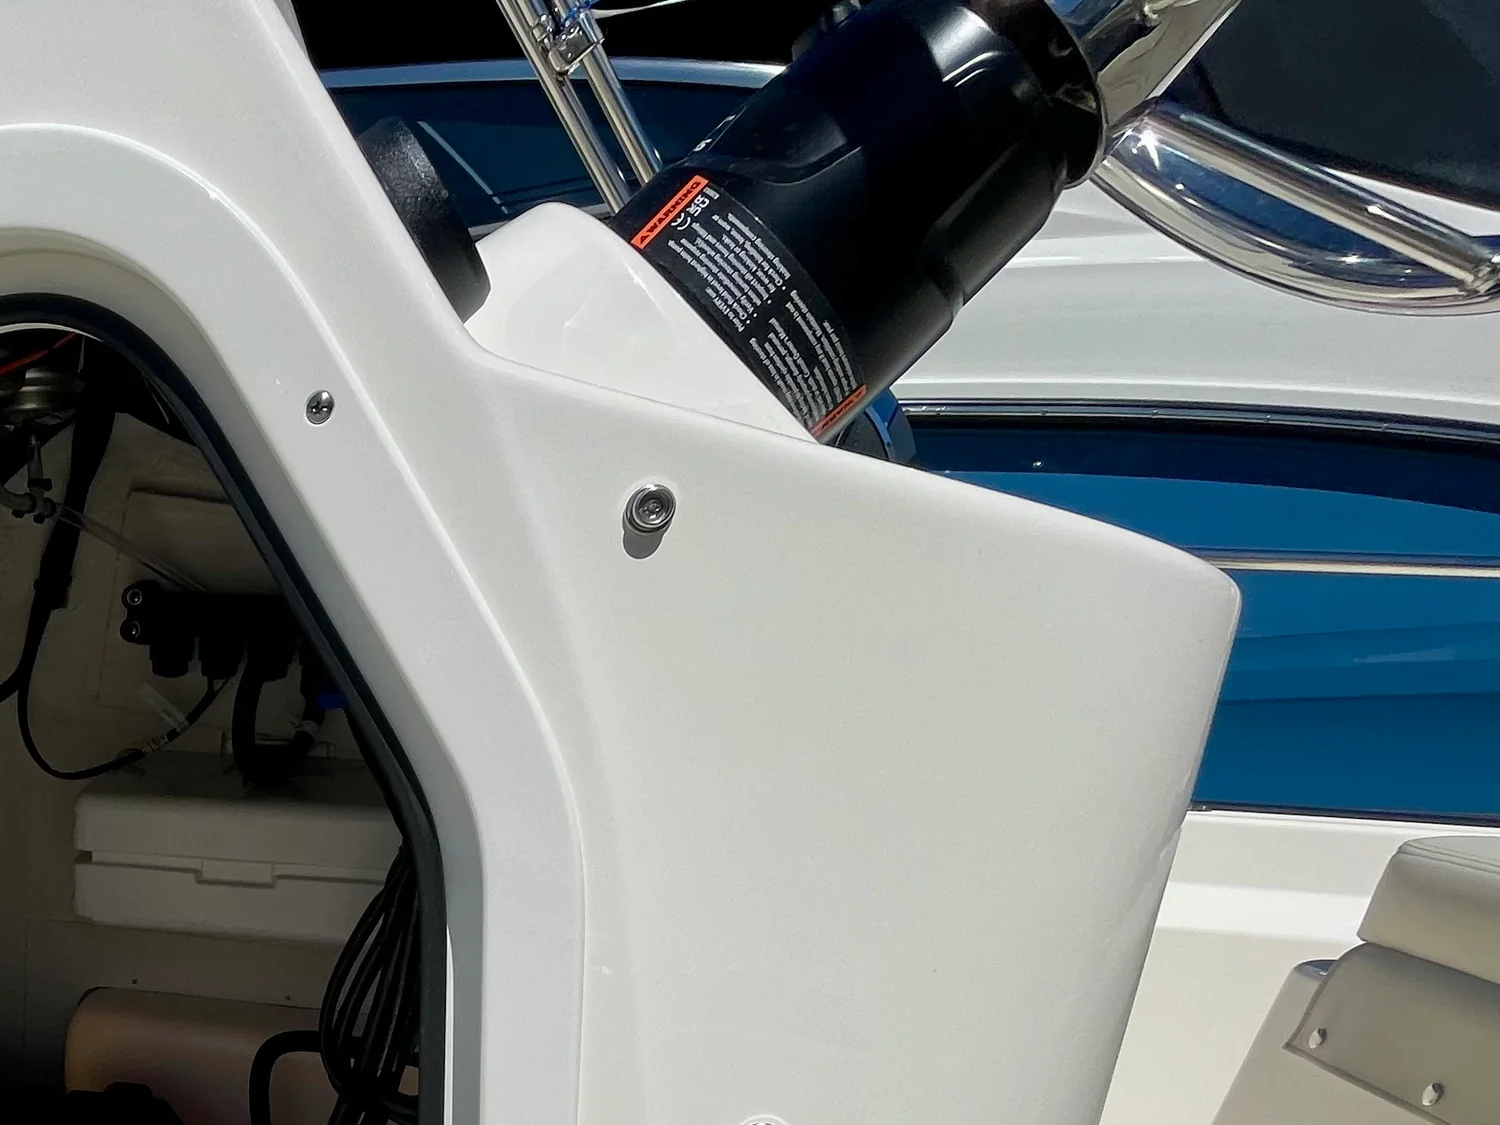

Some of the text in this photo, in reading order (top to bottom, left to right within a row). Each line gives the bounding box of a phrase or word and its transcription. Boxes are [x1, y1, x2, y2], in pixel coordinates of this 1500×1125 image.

[647, 181, 701, 233] WARNING
[754, 238, 775, 260] steering
[690, 259, 709, 278] highest
[699, 253, 720, 274] steering
[714, 253, 734, 275] steering
[727, 253, 748, 275] steering
[739, 250, 757, 272] kinking
[761, 260, 770, 271] for
[772, 257, 791, 280] leaking
[706, 274, 714, 283] in
[717, 271, 742, 300] immediate
[731, 271, 750, 293] turning
[744, 272, 754, 281] all
[767, 268, 783, 286] Check
[710, 279, 725, 294] level
[750, 278, 769, 300] Inspect
[767, 283, 776, 294] for
[713, 297, 730, 315] EVERY
[721, 290, 735, 305] fluid
[740, 295, 754, 314] Verify
[747, 289, 762, 306] when
[790, 290, 808, 314] steering
[727, 311, 735, 320] to
[732, 302, 748, 320] Check
[769, 317, 786, 340] Manual
